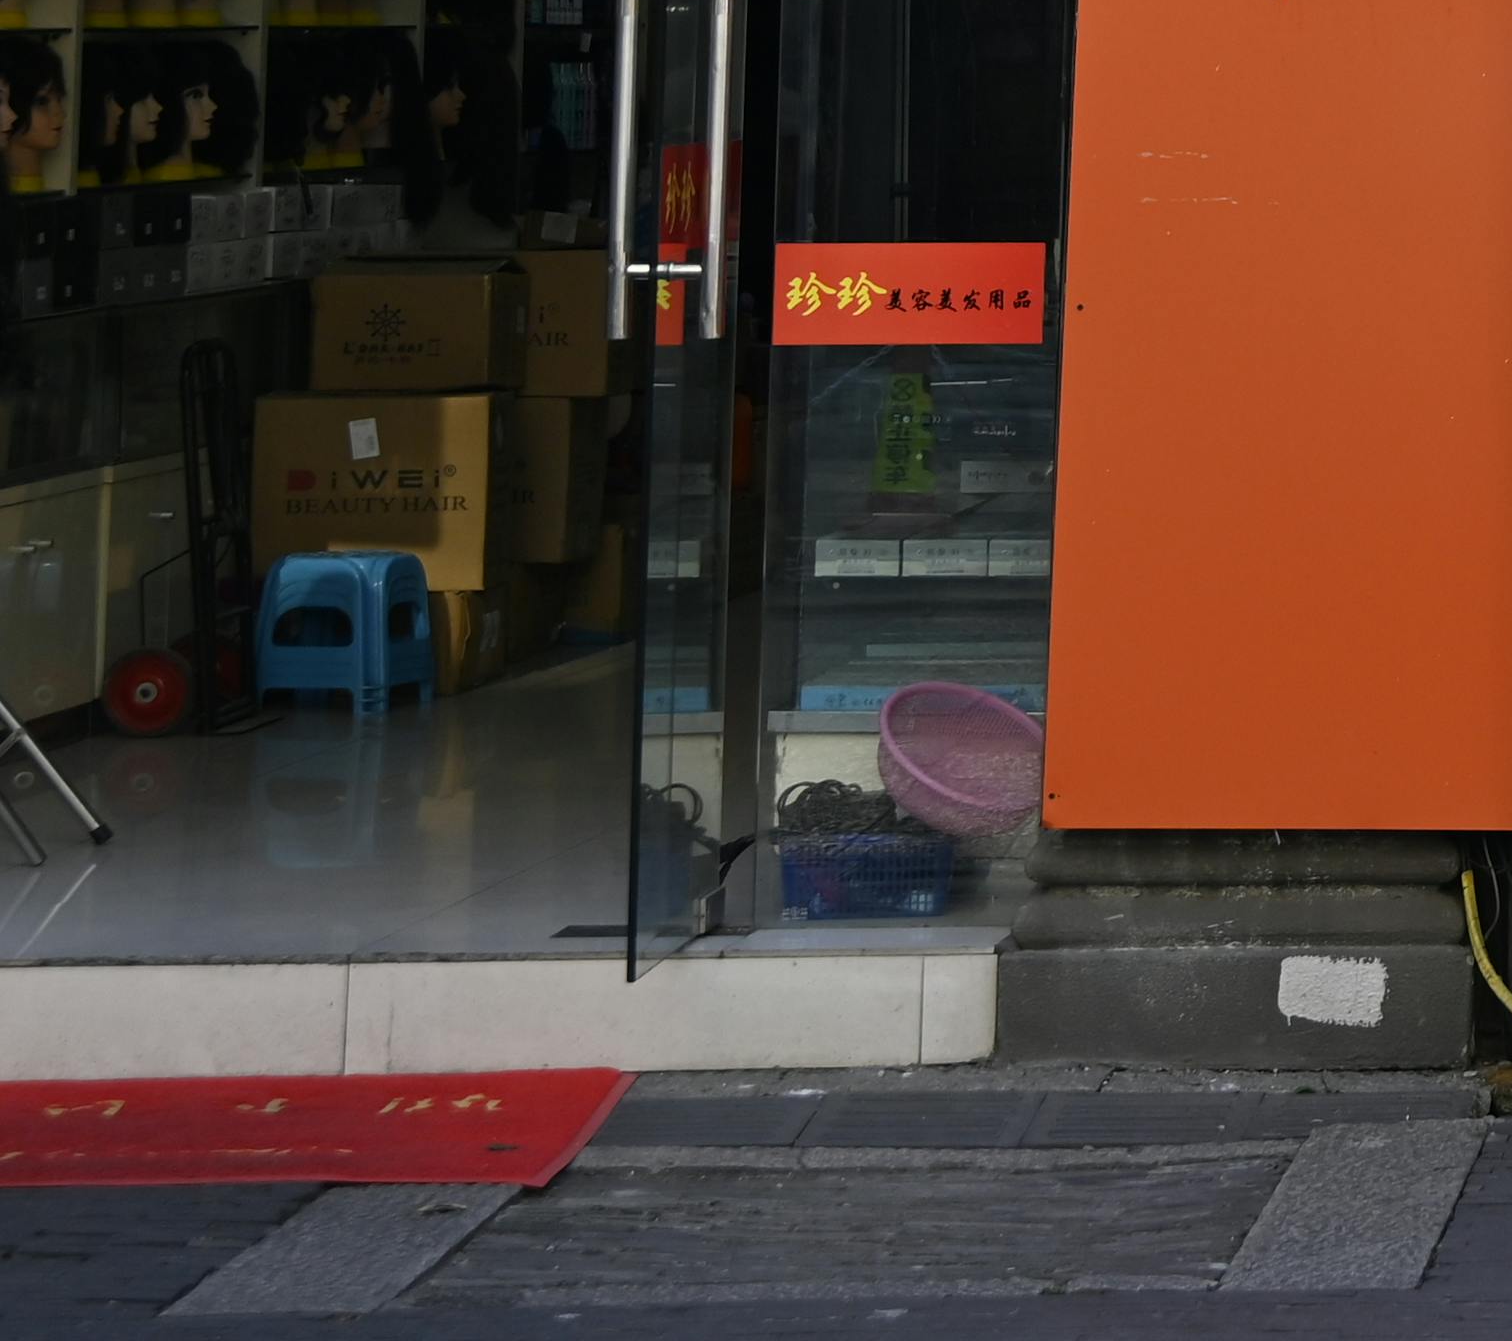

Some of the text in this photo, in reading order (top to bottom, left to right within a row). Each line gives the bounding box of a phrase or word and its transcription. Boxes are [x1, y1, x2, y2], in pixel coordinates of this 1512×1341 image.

[527, 331, 570, 347] AIR
[285, 495, 469, 516] BEAUTY HAIR
